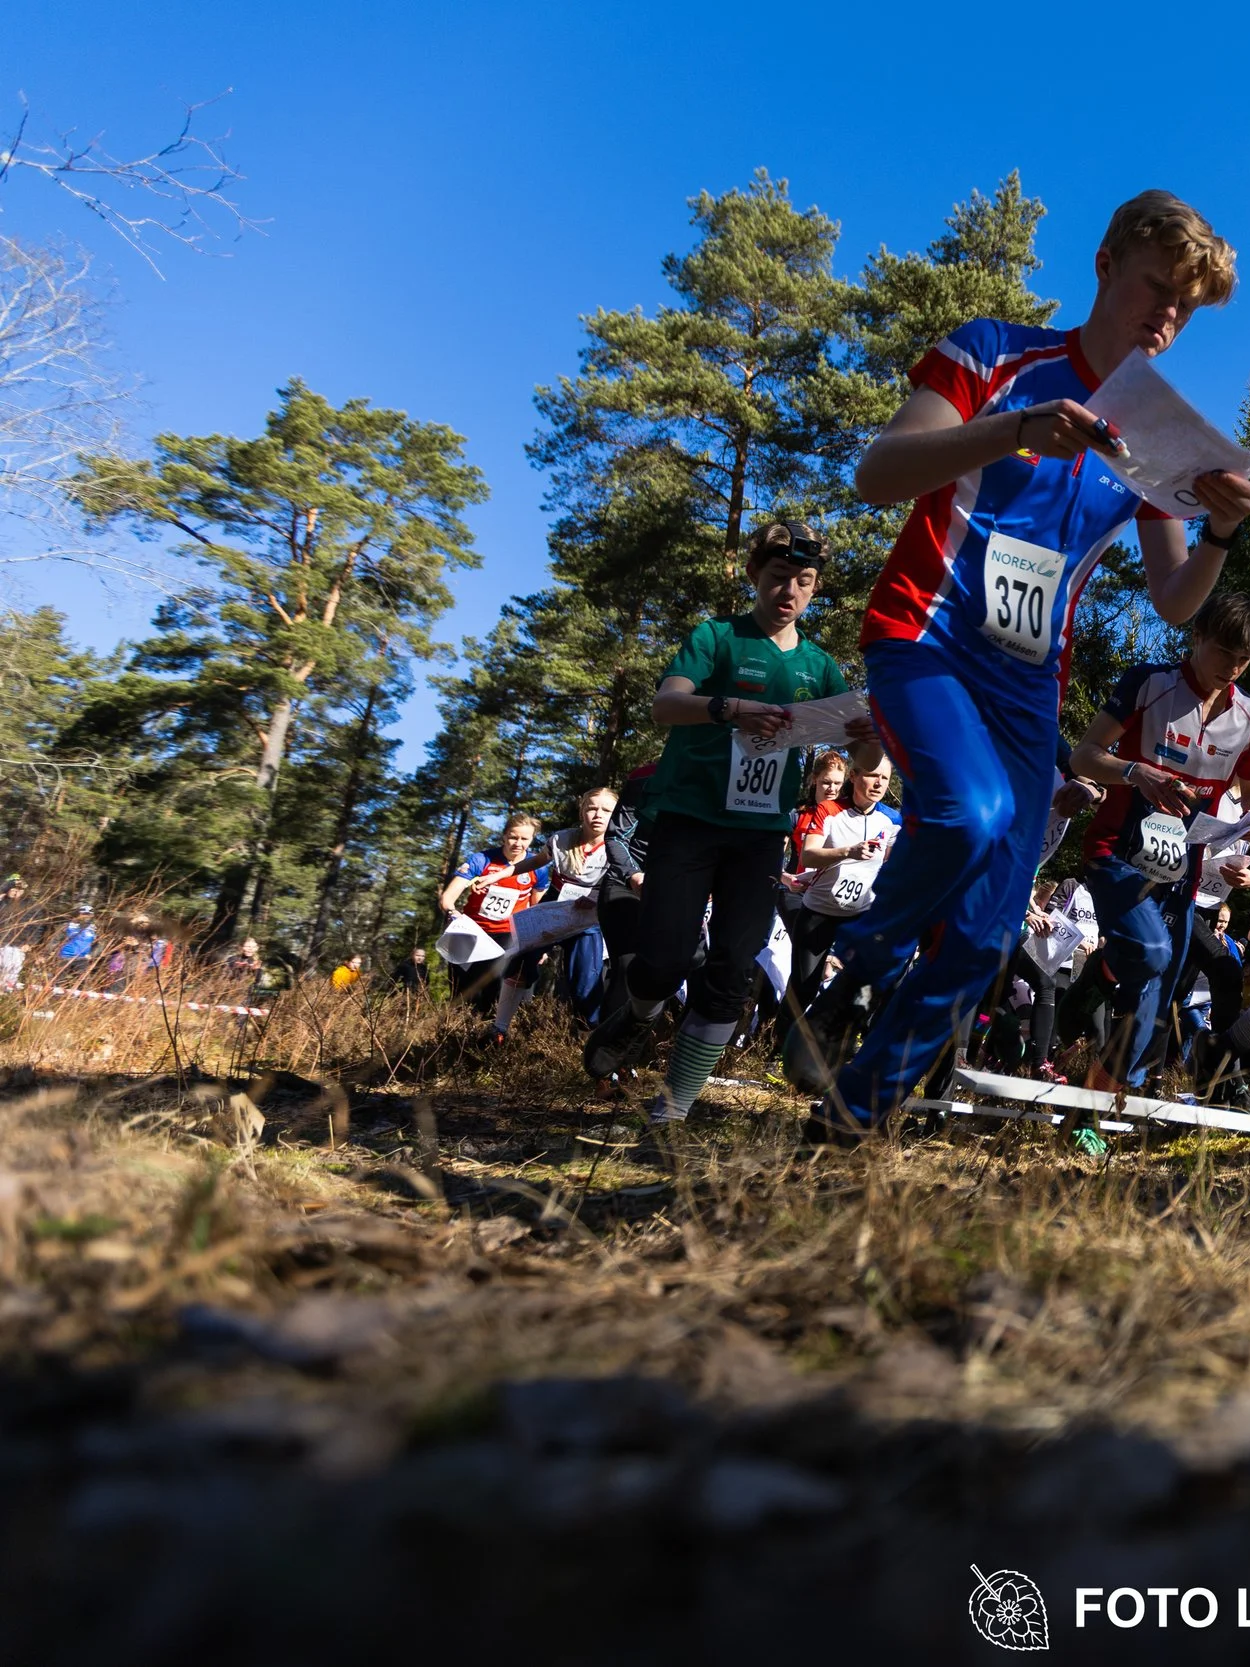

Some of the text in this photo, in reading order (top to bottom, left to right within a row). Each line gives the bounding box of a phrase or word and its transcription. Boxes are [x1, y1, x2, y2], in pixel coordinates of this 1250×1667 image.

[991, 550, 1037, 573] NOREX
[995, 575, 1044, 639] 370
[1004, 639, 1037, 657] Måsen
[737, 757, 777, 795] 380
[734, 798, 746, 807] OK
[1144, 821, 1172, 834] NOREX
[1144, 836, 1182, 871] 369
[835, 879, 863, 902] 299
[485, 896, 510, 914] 259
[1053, 921, 1072, 941] 297
